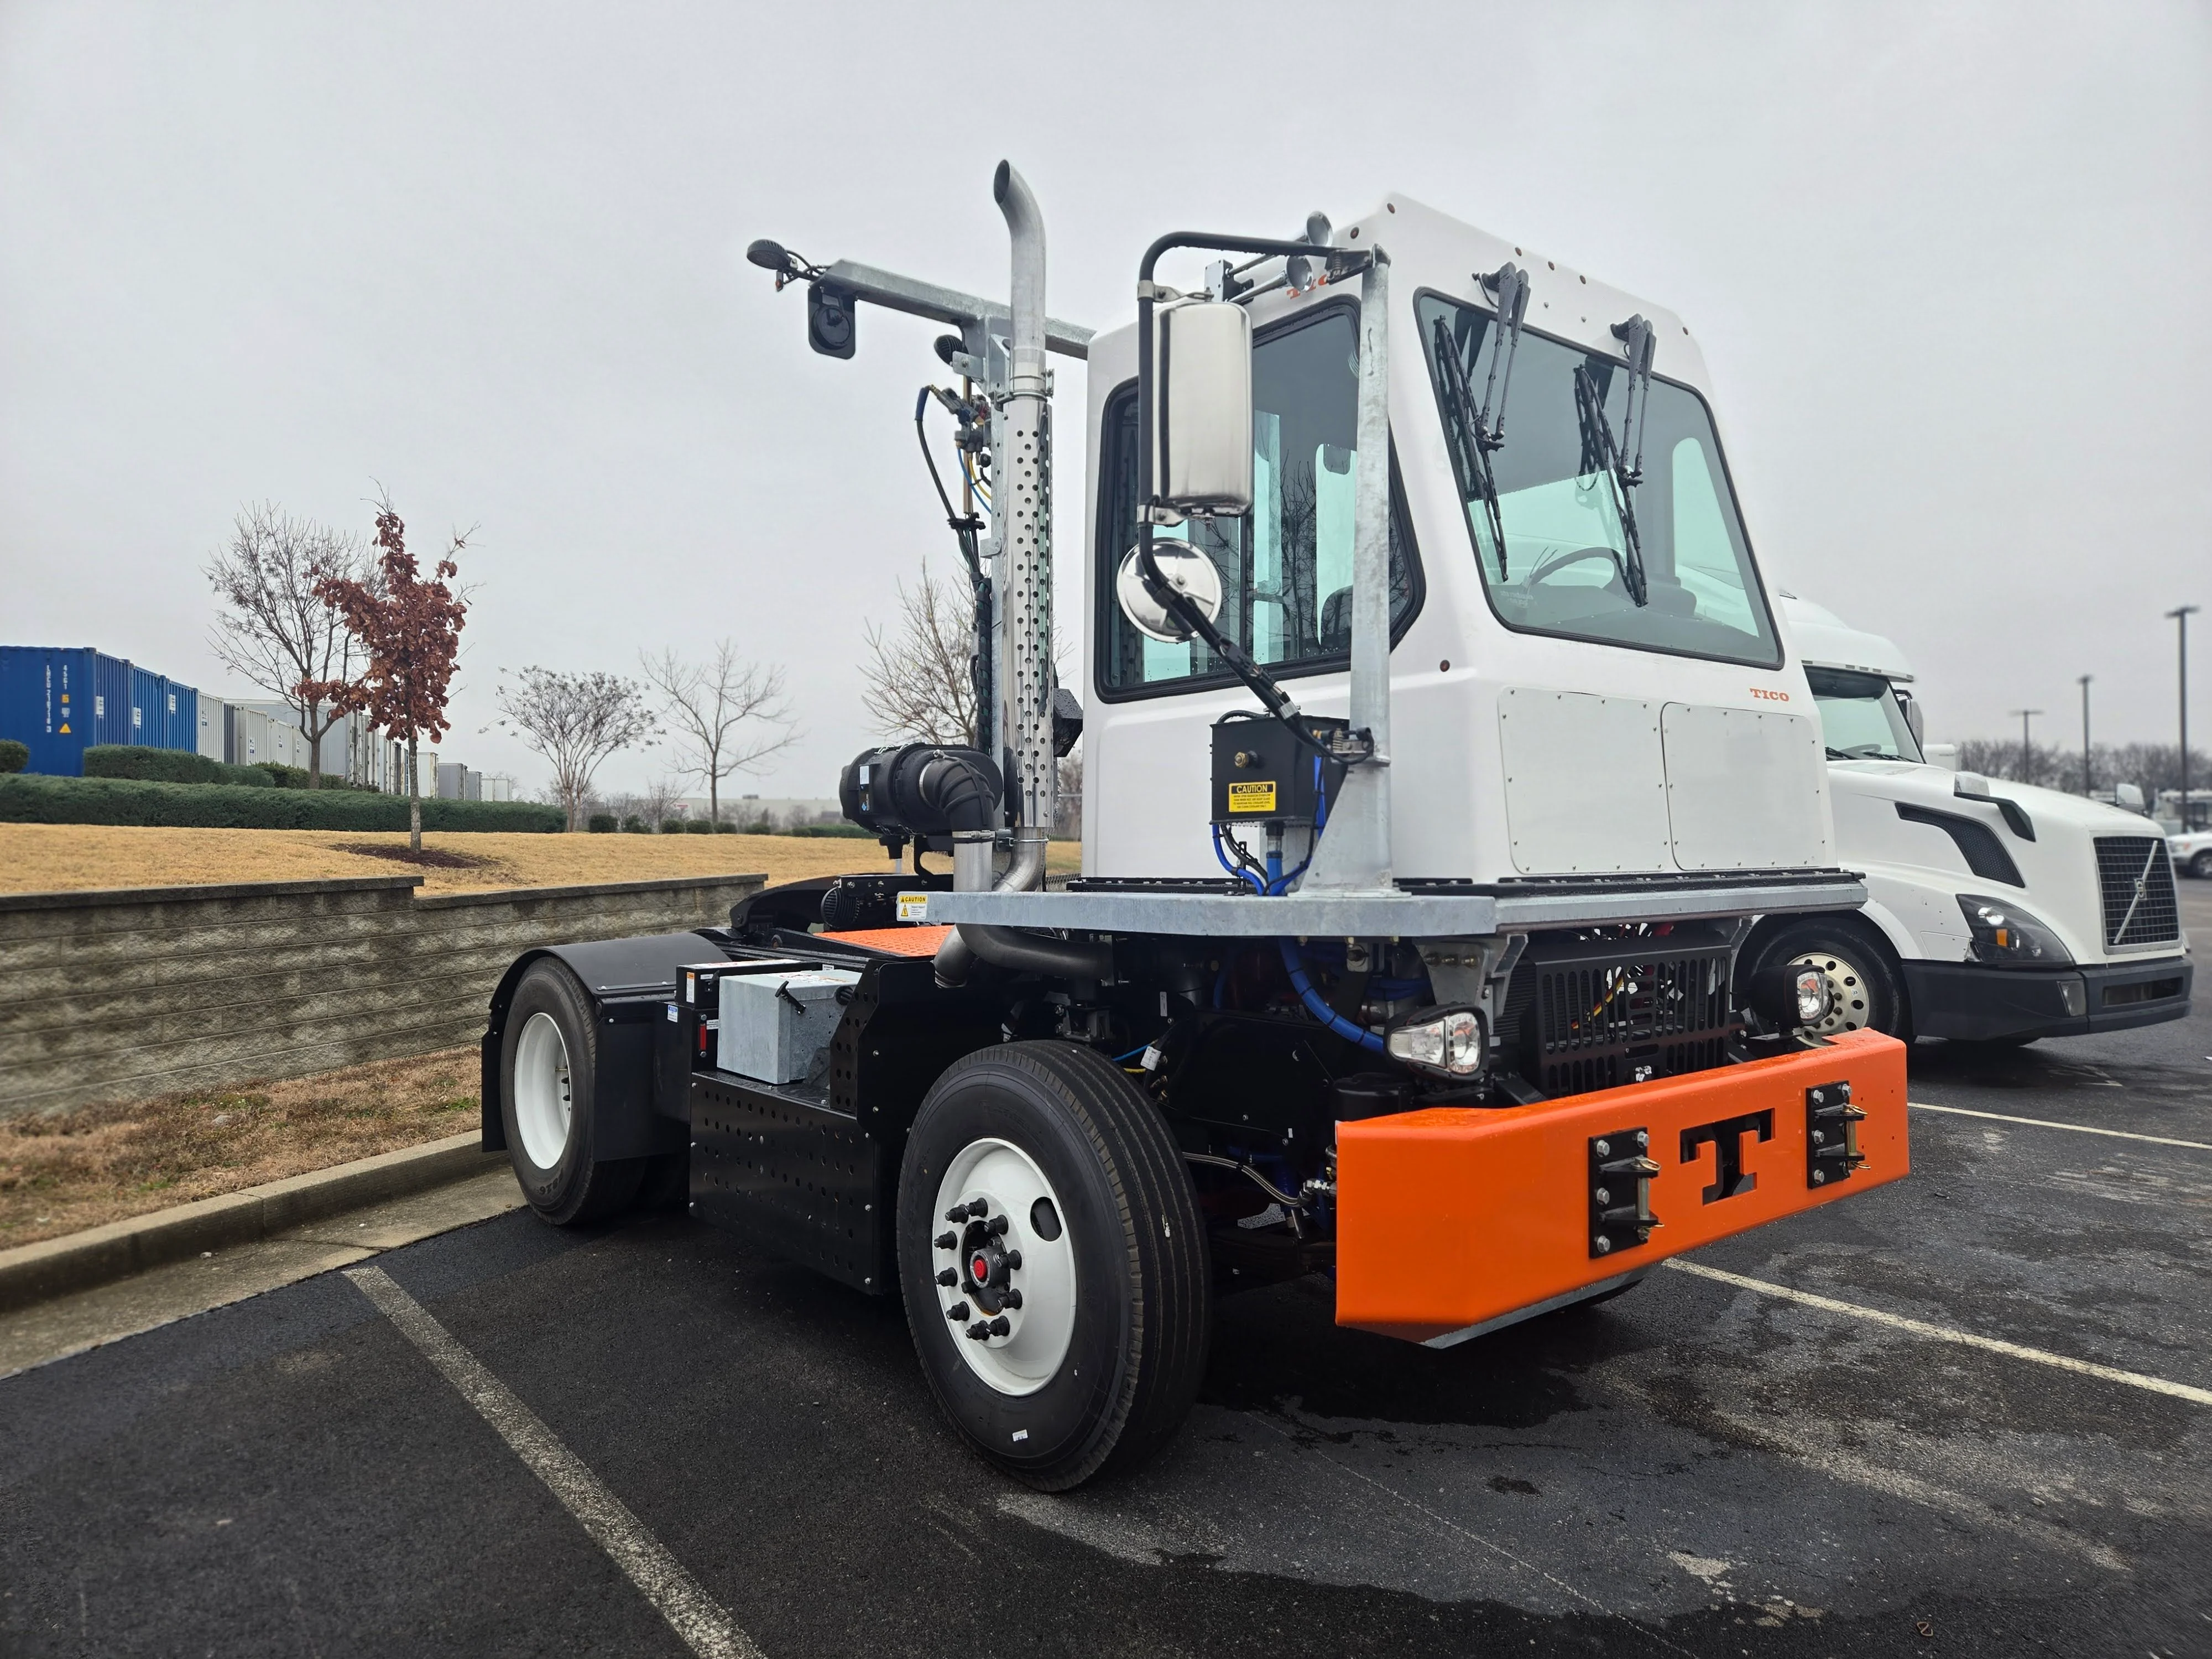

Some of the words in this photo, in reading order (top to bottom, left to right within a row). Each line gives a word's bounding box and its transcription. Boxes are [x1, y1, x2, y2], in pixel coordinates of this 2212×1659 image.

[1749, 688, 1790, 702] TICO
[1237, 784, 1267, 793] CAUTION
[1679, 1108, 1776, 1207] T
